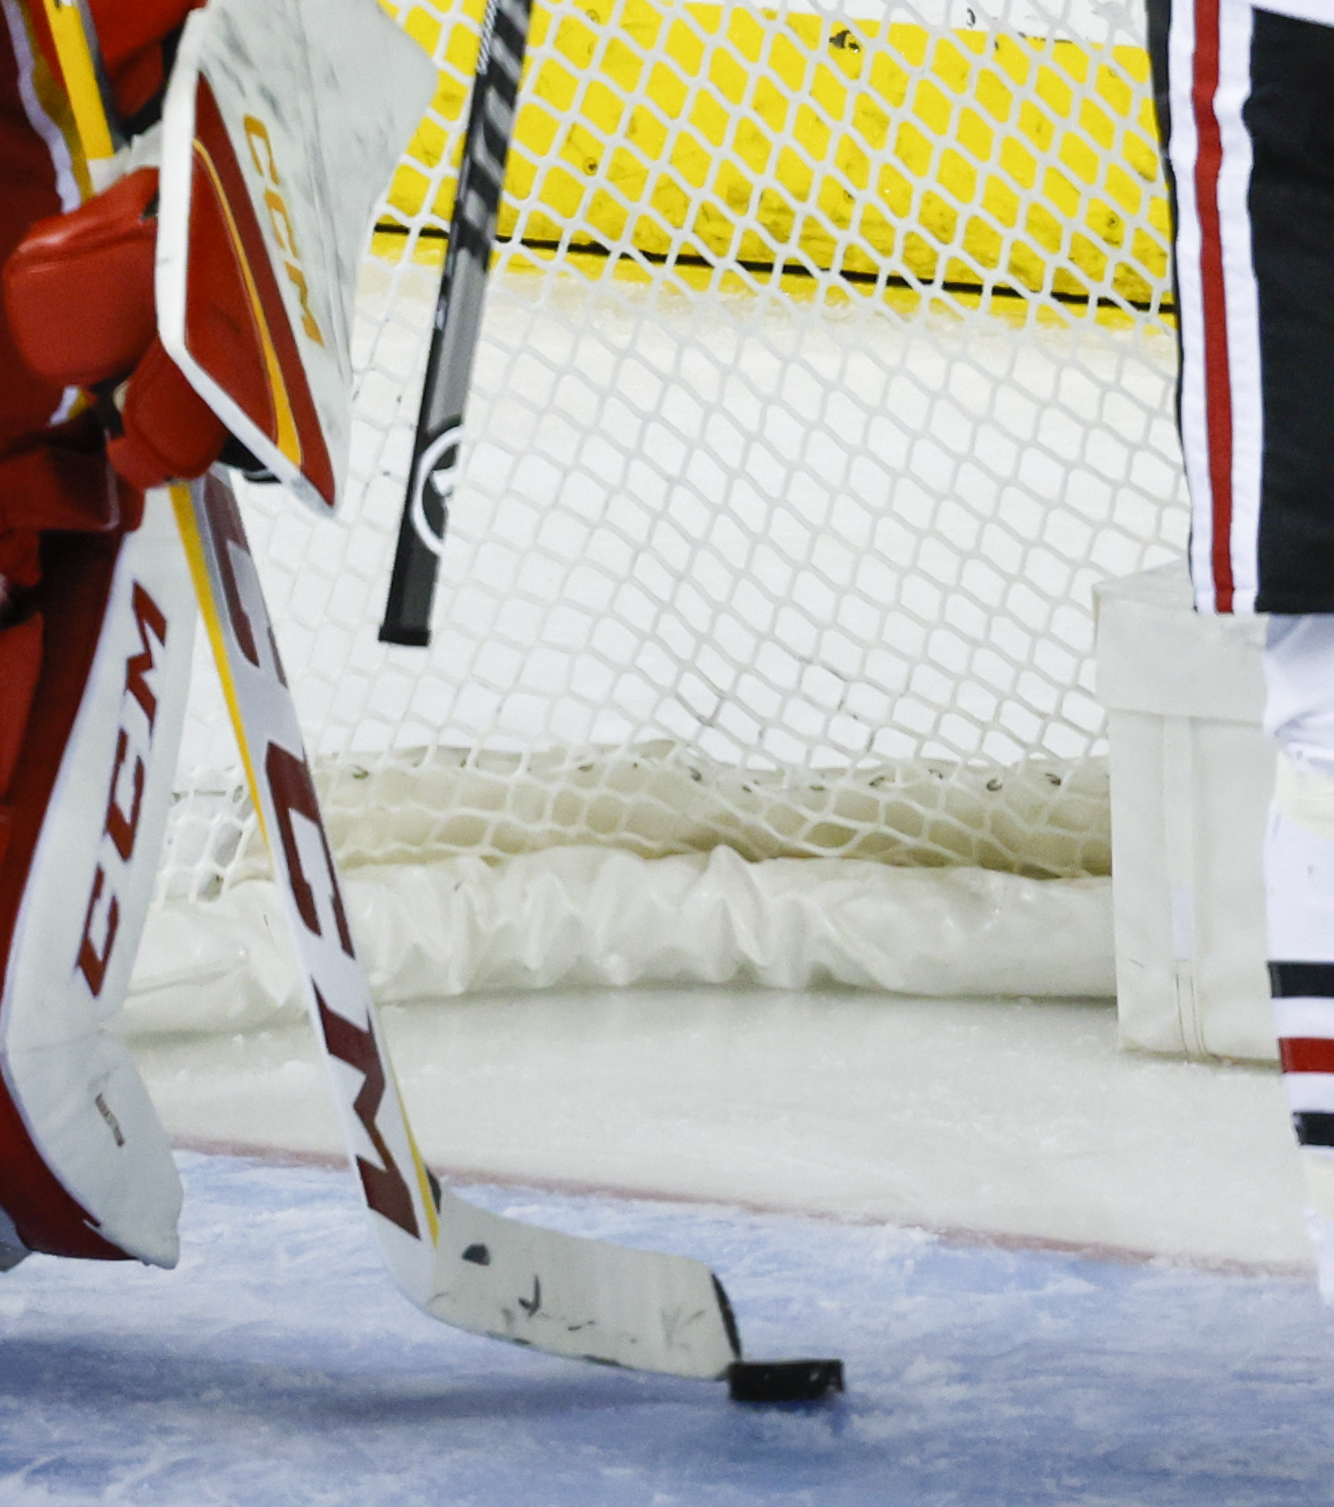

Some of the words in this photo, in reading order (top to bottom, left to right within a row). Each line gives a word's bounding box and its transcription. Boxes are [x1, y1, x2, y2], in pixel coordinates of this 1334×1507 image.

[242, 113, 325, 349] CCM
[75, 577, 169, 999] CCM
[202, 463, 423, 1241] CCM
